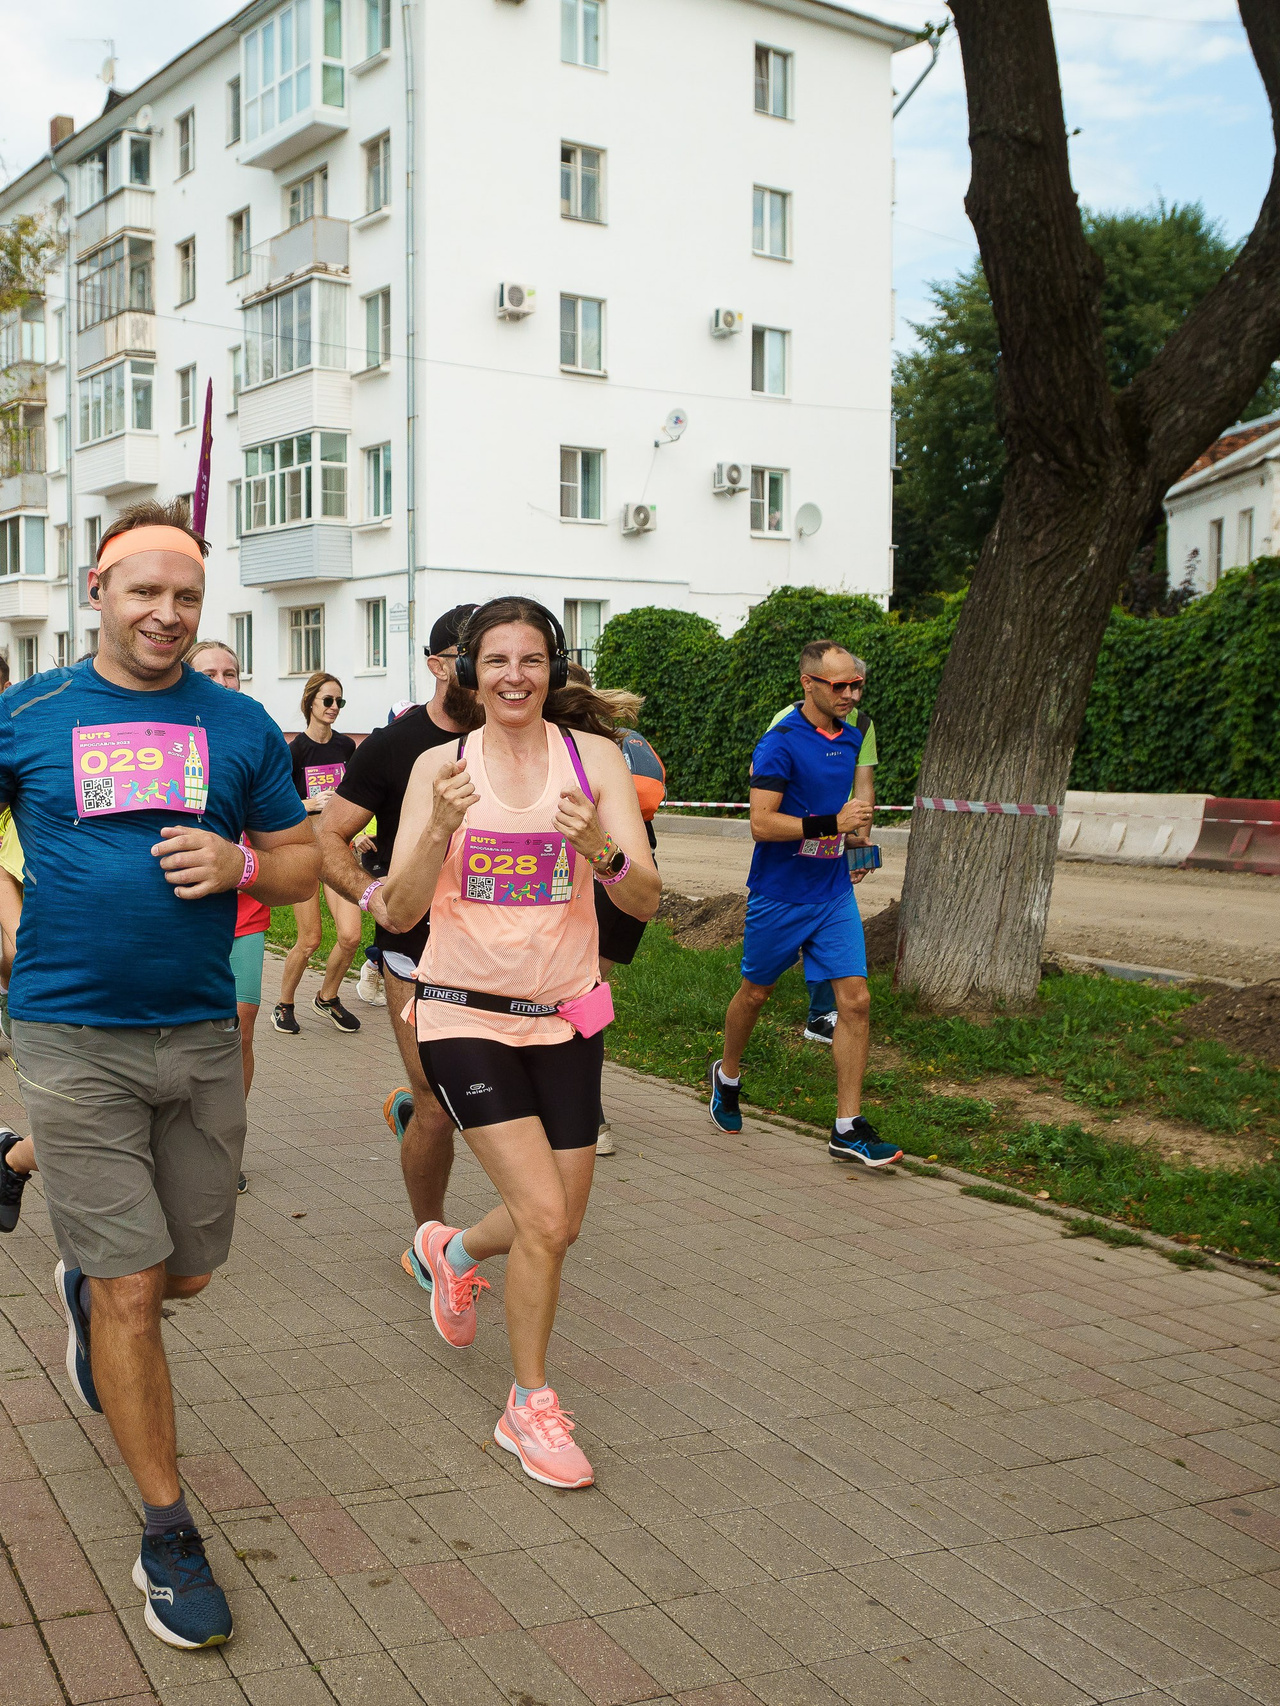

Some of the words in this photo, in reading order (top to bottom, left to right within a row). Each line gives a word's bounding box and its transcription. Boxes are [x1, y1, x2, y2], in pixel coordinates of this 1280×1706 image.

[79, 731, 111, 741] RUTS
[172, 742, 184, 753] 3
[80, 747, 164, 775] 029
[308, 774, 335, 786] 235
[470, 835, 497, 845] RUTS
[543, 843, 553, 853] 3
[468, 853, 538, 875] 028
[423, 988, 468, 1002] FITNESS
[510, 1002, 556, 1013] FITNESS
